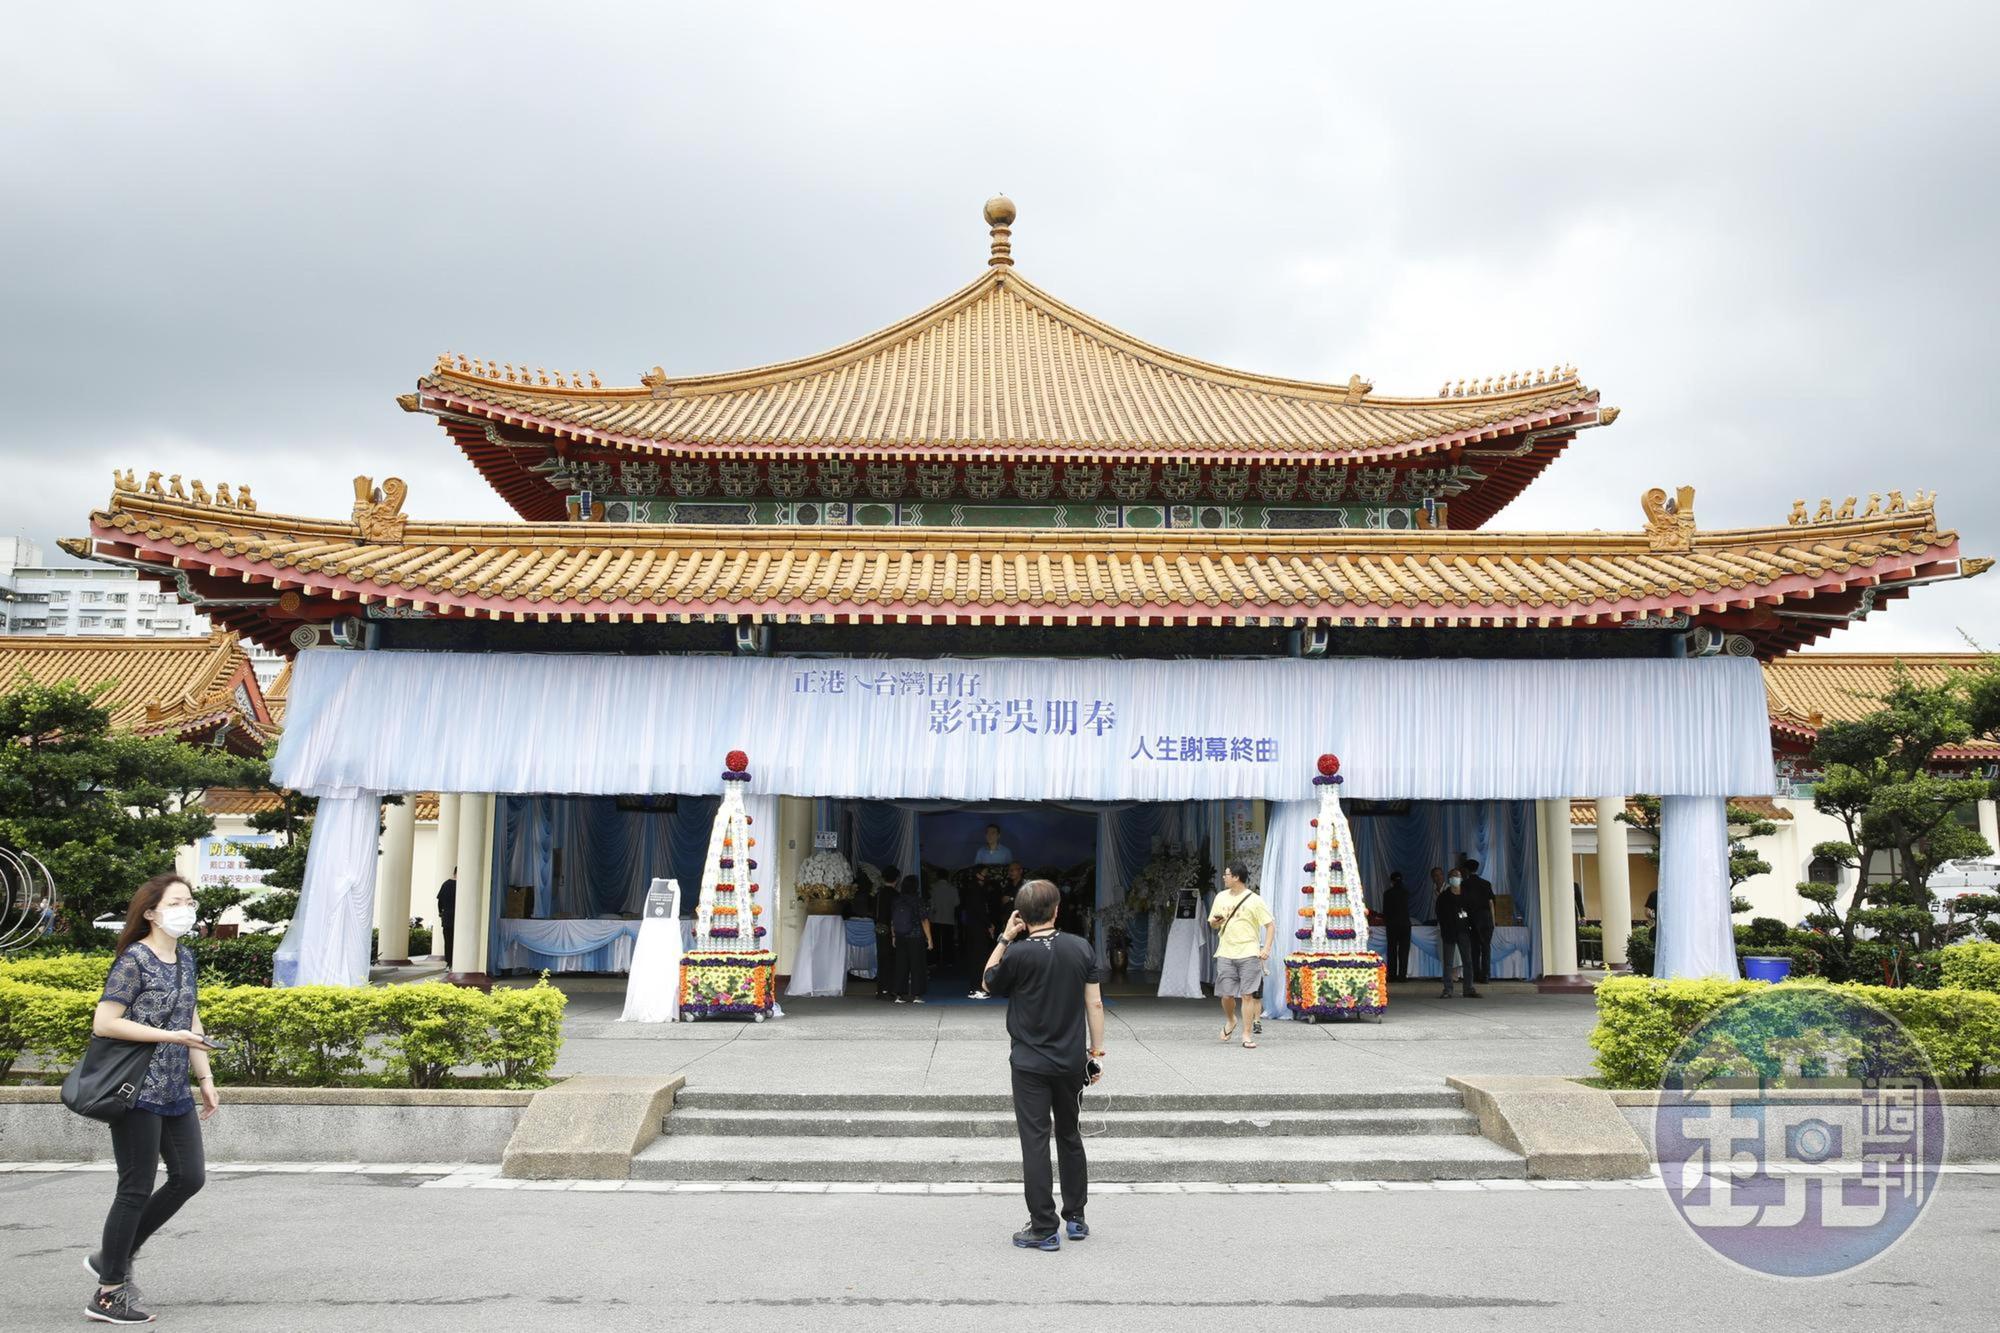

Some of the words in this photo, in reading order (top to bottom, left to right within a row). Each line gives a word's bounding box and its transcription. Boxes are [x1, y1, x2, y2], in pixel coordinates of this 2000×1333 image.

[928, 697, 1116, 737] 影帝吳朋奉
[1130, 735, 1279, 762] 人生謝幕終曲
